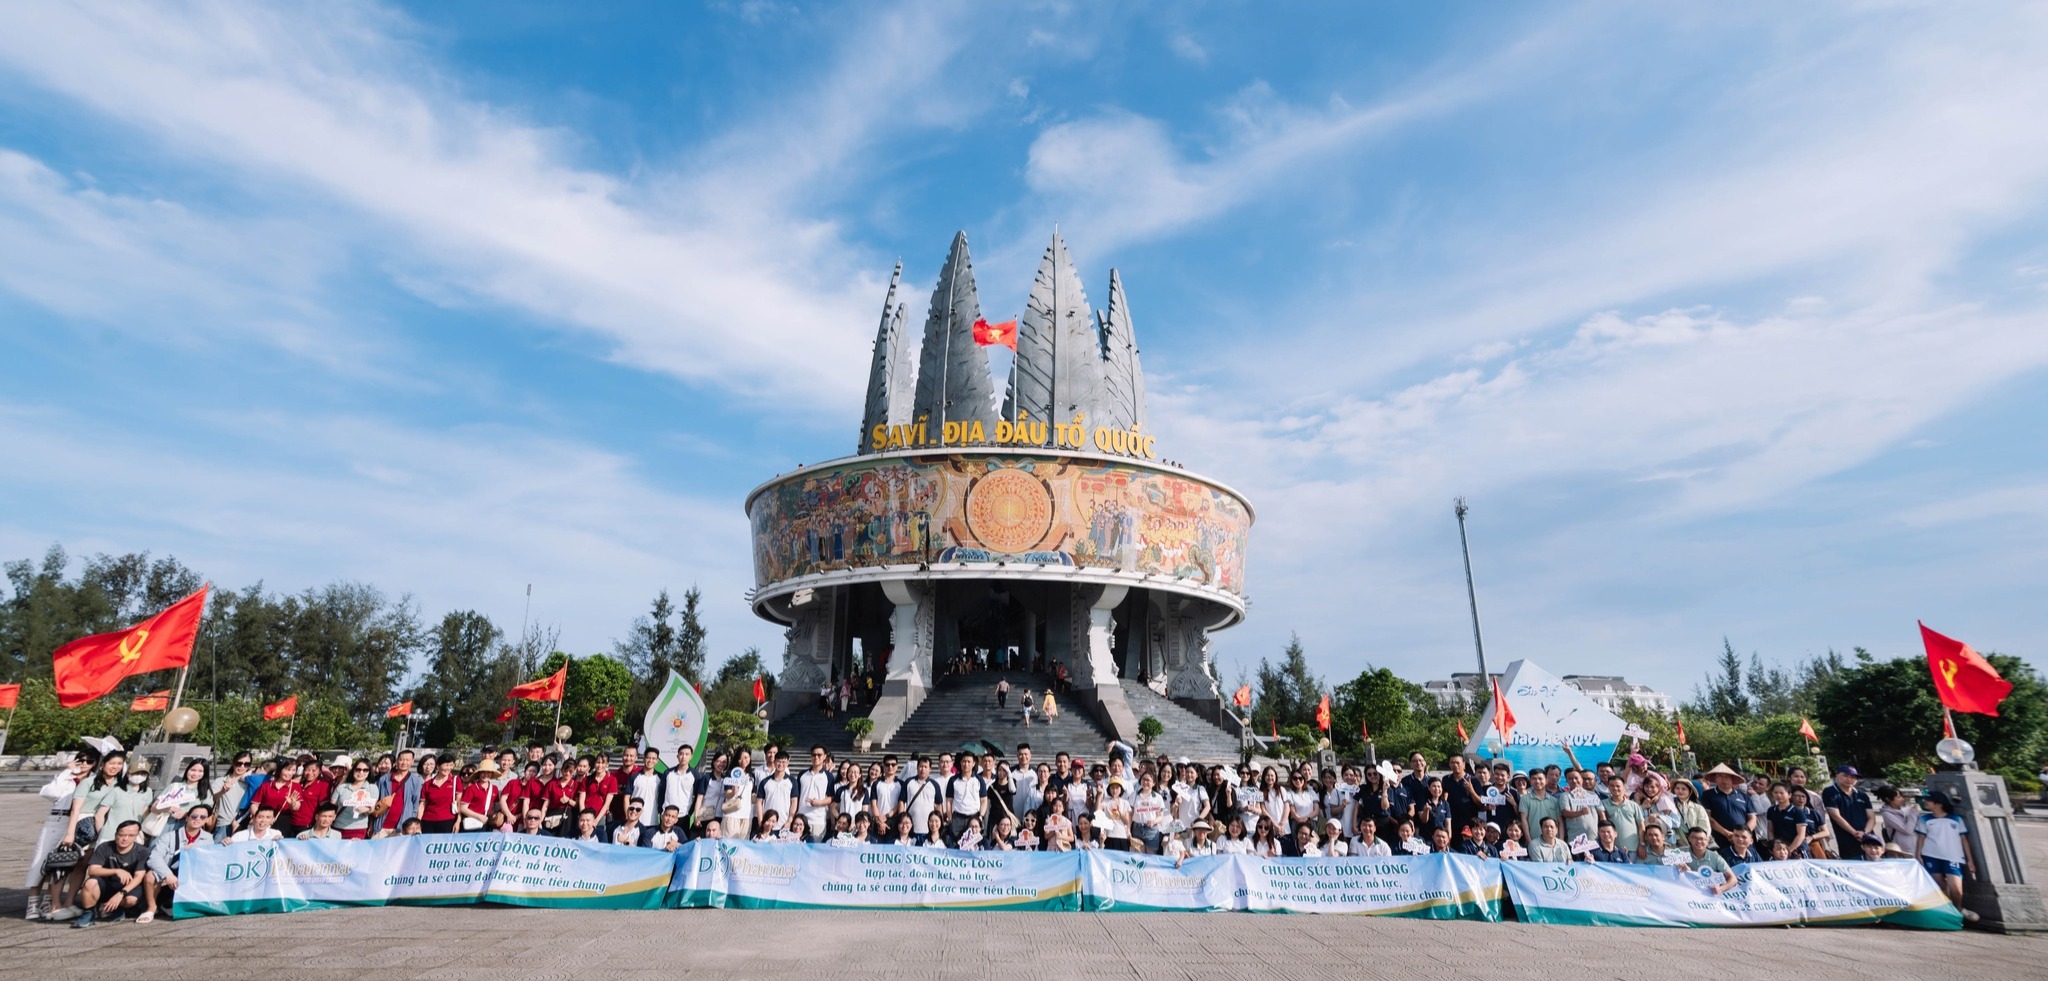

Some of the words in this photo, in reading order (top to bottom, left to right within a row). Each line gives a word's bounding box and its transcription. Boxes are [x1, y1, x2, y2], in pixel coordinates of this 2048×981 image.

[942, 420, 986, 448] ĐỊA
[995, 410, 1046, 444] ĐẦU
[1054, 412, 1086, 448] TỔ
[1094, 422, 1157, 459] QUỐC
[426, 842, 470, 855] CHUNG
[474, 837, 500, 853] SỨC
[502, 837, 540, 856] ĐỒNG
[544, 843, 578, 860] LÒNG
[429, 859, 450, 870] Hợp
[699, 857, 724, 873] DK
[731, 858, 795, 878] Pharma
[860, 852, 901, 865] CHUNG
[906, 850, 929, 866] SỨC
[933, 850, 967, 868] ĐỒNG
[971, 855, 1003, 869] LÒNG
[225, 860, 260, 881] DK
[270, 859, 351, 876] Pharma
[865, 869, 885, 881] Hợp
[909, 868, 933, 880] đoàn
[1112, 869, 1137, 885] DK
[1261, 864, 1304, 877] CHUNG
[1307, 860, 1332, 876] SỨC
[1335, 860, 1371, 876] ĐỒNG
[1375, 861, 1409, 875] LÒNG
[384, 874, 414, 886] chúng
[418, 874, 428, 883] ta
[446, 872, 471, 883] cùng
[522, 875, 546, 887] mục
[548, 877, 569, 888] tiêu
[572, 880, 606, 892] chung
[822, 882, 853, 894] chúng
[856, 883, 867, 893] ta
[869, 882, 881, 893] sẽ
[883, 880, 908, 894] cùng
[911, 882, 928, 895] đạt
[930, 881, 957, 894] được
[959, 885, 980, 896] mục
[984, 883, 1003, 896] tiêu
[1006, 886, 1037, 898] chung
[1270, 878, 1290, 890] Hợp
[1314, 878, 1340, 890] đoàn
[1542, 876, 1574, 891] DK
[1234, 887, 1263, 900] chúng
[1265, 891, 1276, 900] ta
[1292, 891, 1317, 904] cùng
[1320, 891, 1337, 904] đạt
[1340, 890, 1368, 902] được
[1370, 891, 1393, 903] mục
[1395, 889, 1416, 901] tiêu
[1419, 889, 1452, 902] chung
[1723, 902, 1737, 911] ta
[1825, 900, 1847, 911] mục
[1850, 896, 1870, 908] tiêu
[1874, 897, 1909, 909] chung
